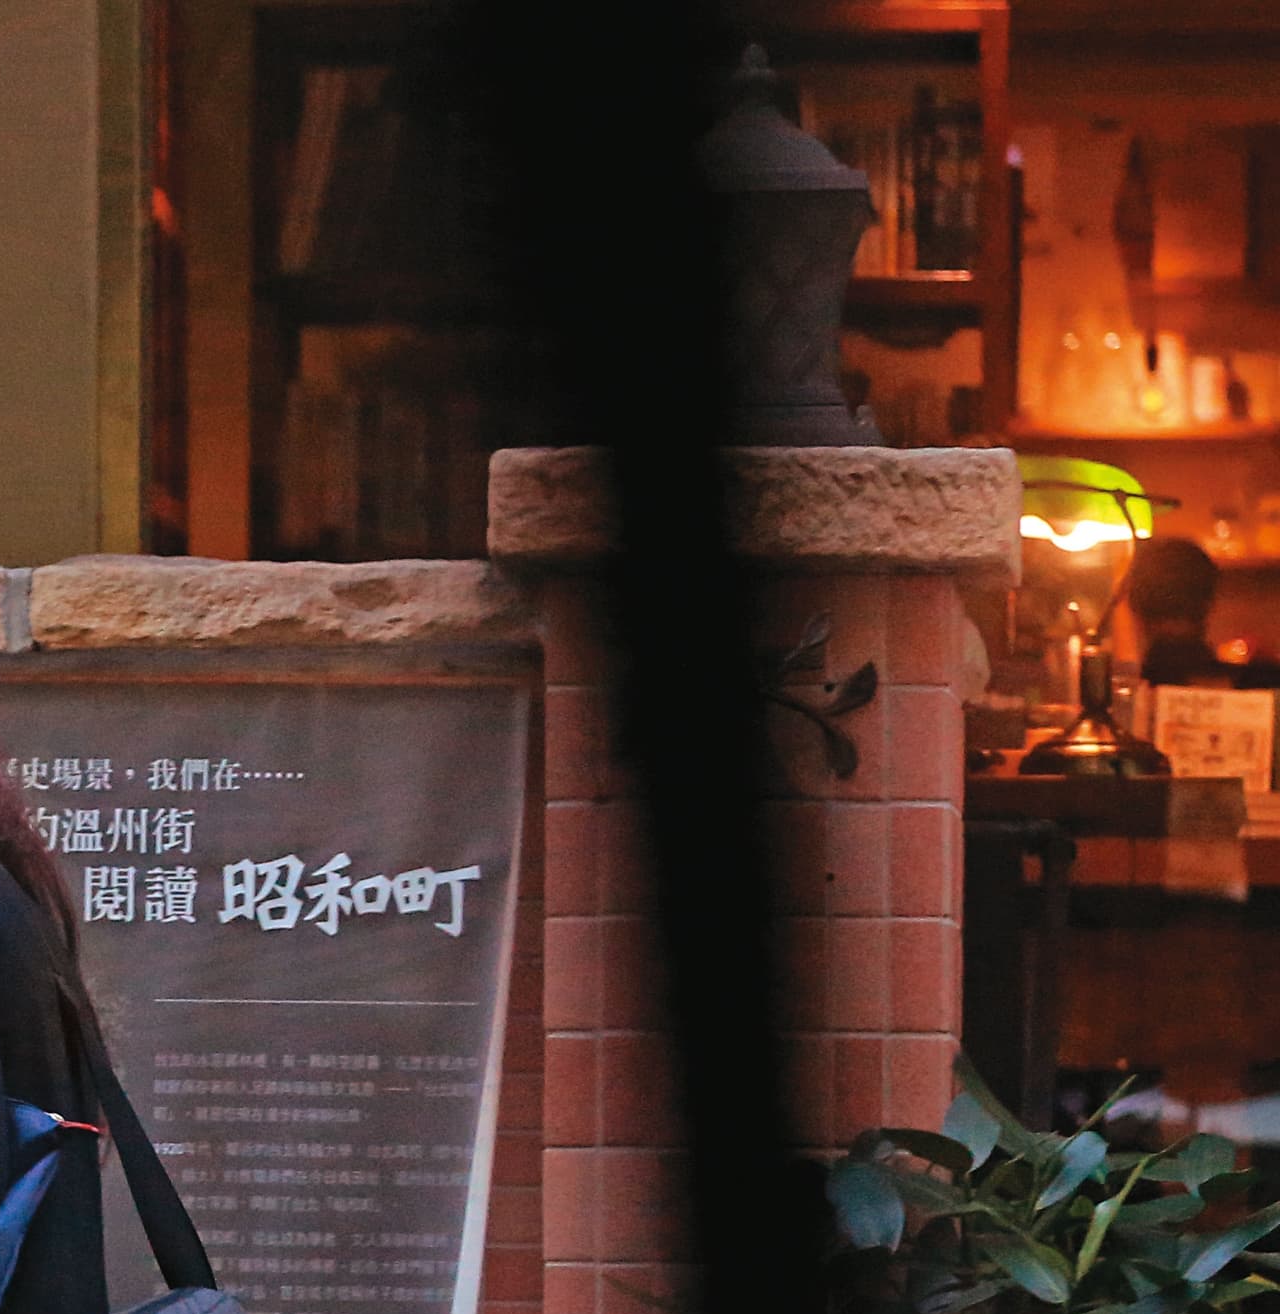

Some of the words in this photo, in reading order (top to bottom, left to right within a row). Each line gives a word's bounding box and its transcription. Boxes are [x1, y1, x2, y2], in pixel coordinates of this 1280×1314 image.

[83, 866, 197, 923] 閱讀
[218, 852, 481, 937] 昭和町
